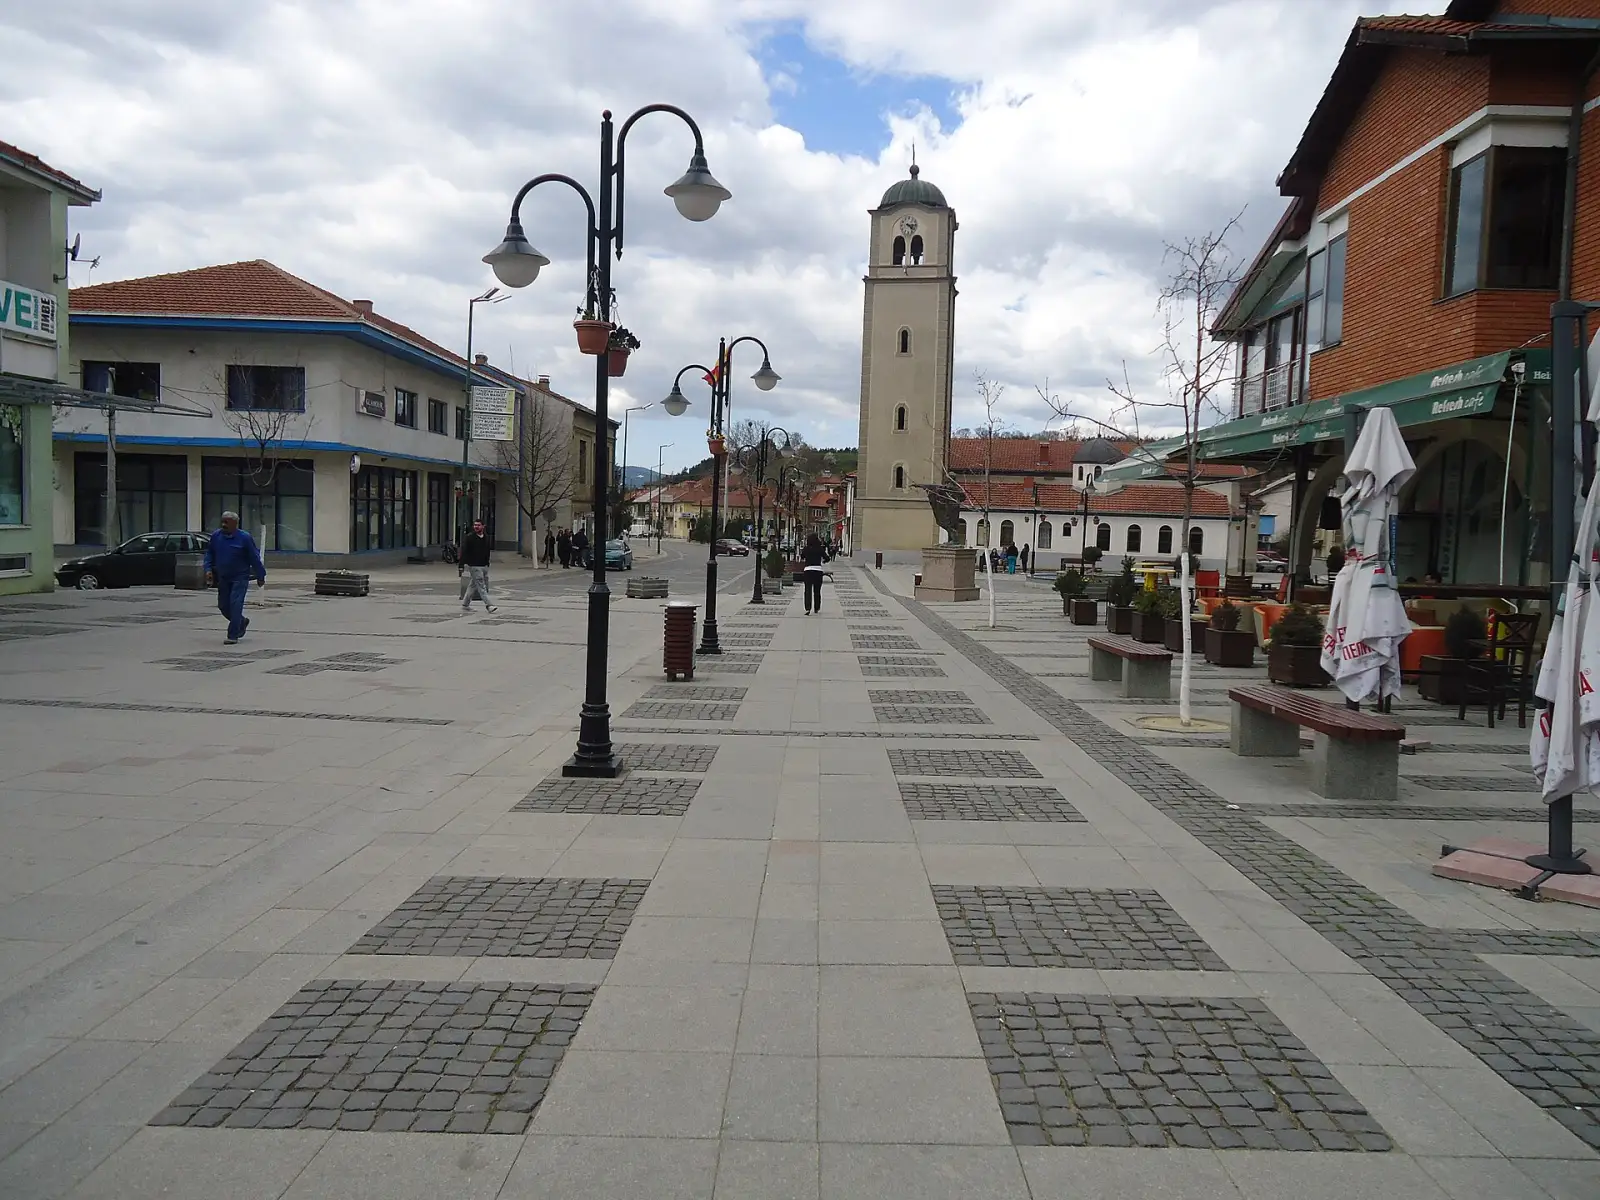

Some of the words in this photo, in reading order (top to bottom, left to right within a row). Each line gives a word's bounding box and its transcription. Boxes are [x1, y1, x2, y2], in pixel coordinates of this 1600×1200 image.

[1430, 368, 1463, 388] Refresh
[1432, 397, 1463, 415] Refresh
[1464, 391, 1485, 412] cafe
